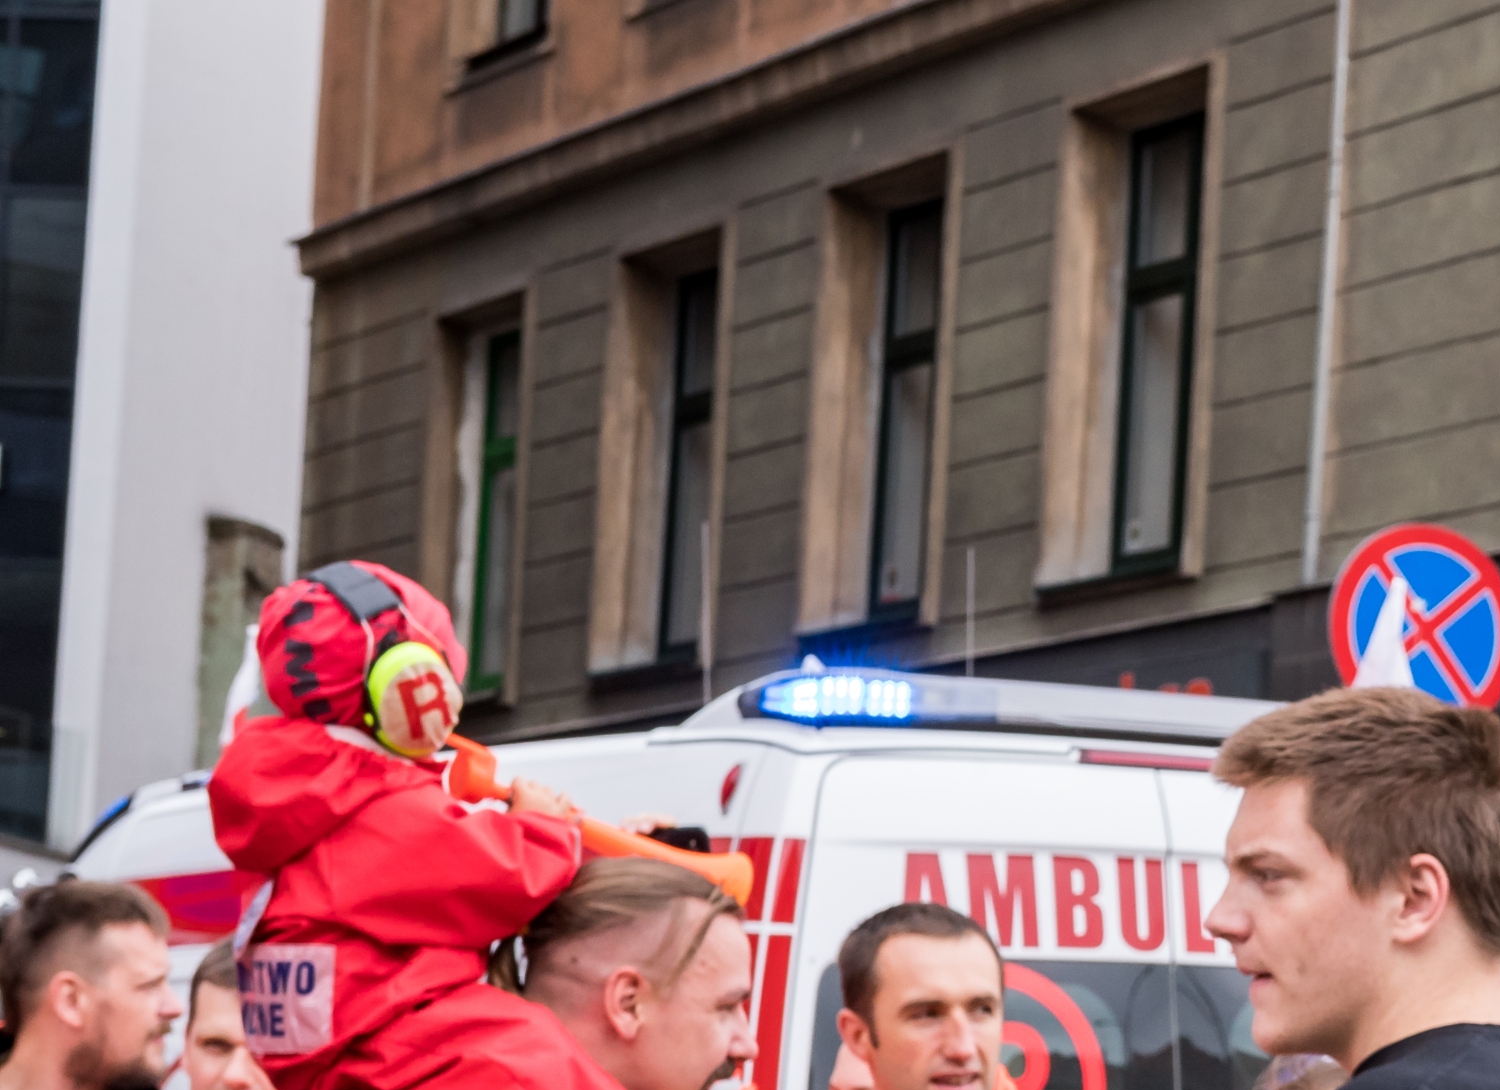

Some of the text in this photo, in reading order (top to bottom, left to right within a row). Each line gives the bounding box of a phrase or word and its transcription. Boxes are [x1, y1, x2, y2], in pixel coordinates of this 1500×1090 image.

[397, 671, 453, 740] R
[904, 851, 1216, 954] AMBUL
[236, 961, 316, 996] TWO
